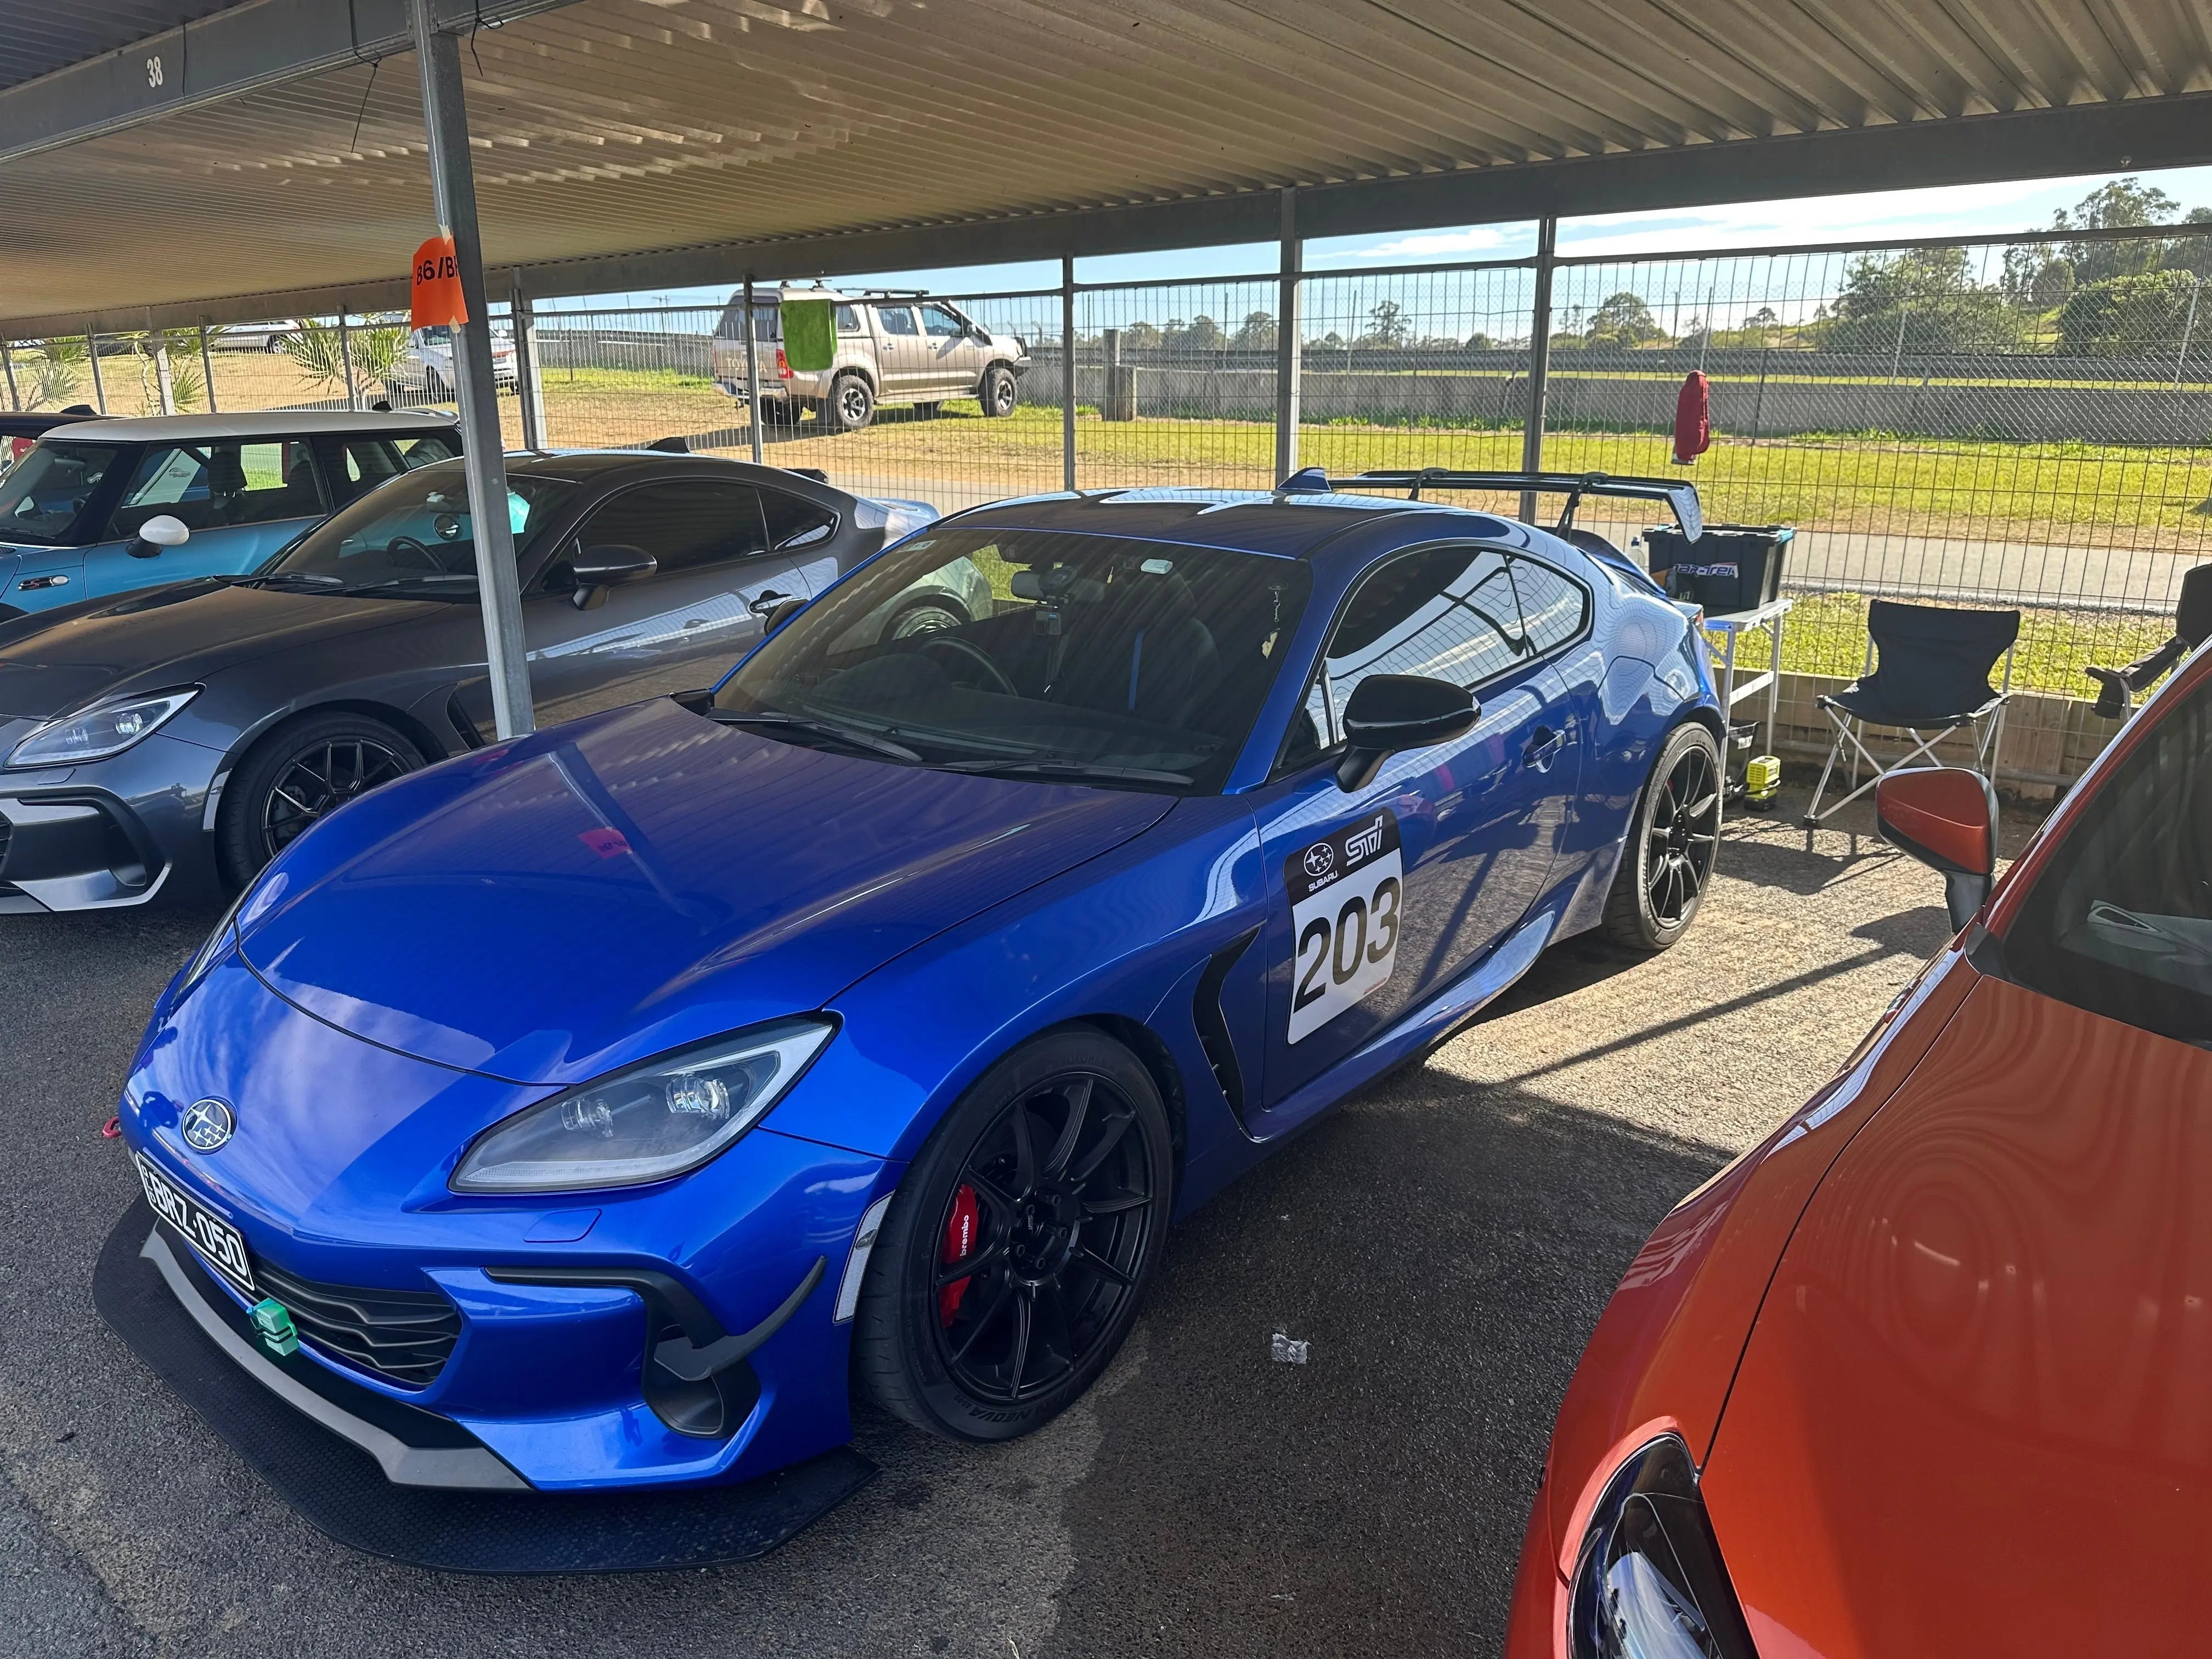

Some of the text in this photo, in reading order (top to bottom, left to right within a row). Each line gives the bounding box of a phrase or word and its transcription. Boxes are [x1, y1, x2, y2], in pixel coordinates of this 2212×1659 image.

[146, 56, 163, 88] 38
[725, 357, 768, 374] TOYA
[1308, 870, 1338, 892] SUBARU
[1293, 876, 1401, 1014] 203
[141, 1164, 156, 1204] QLD
[959, 1215, 969, 1257] brembo
